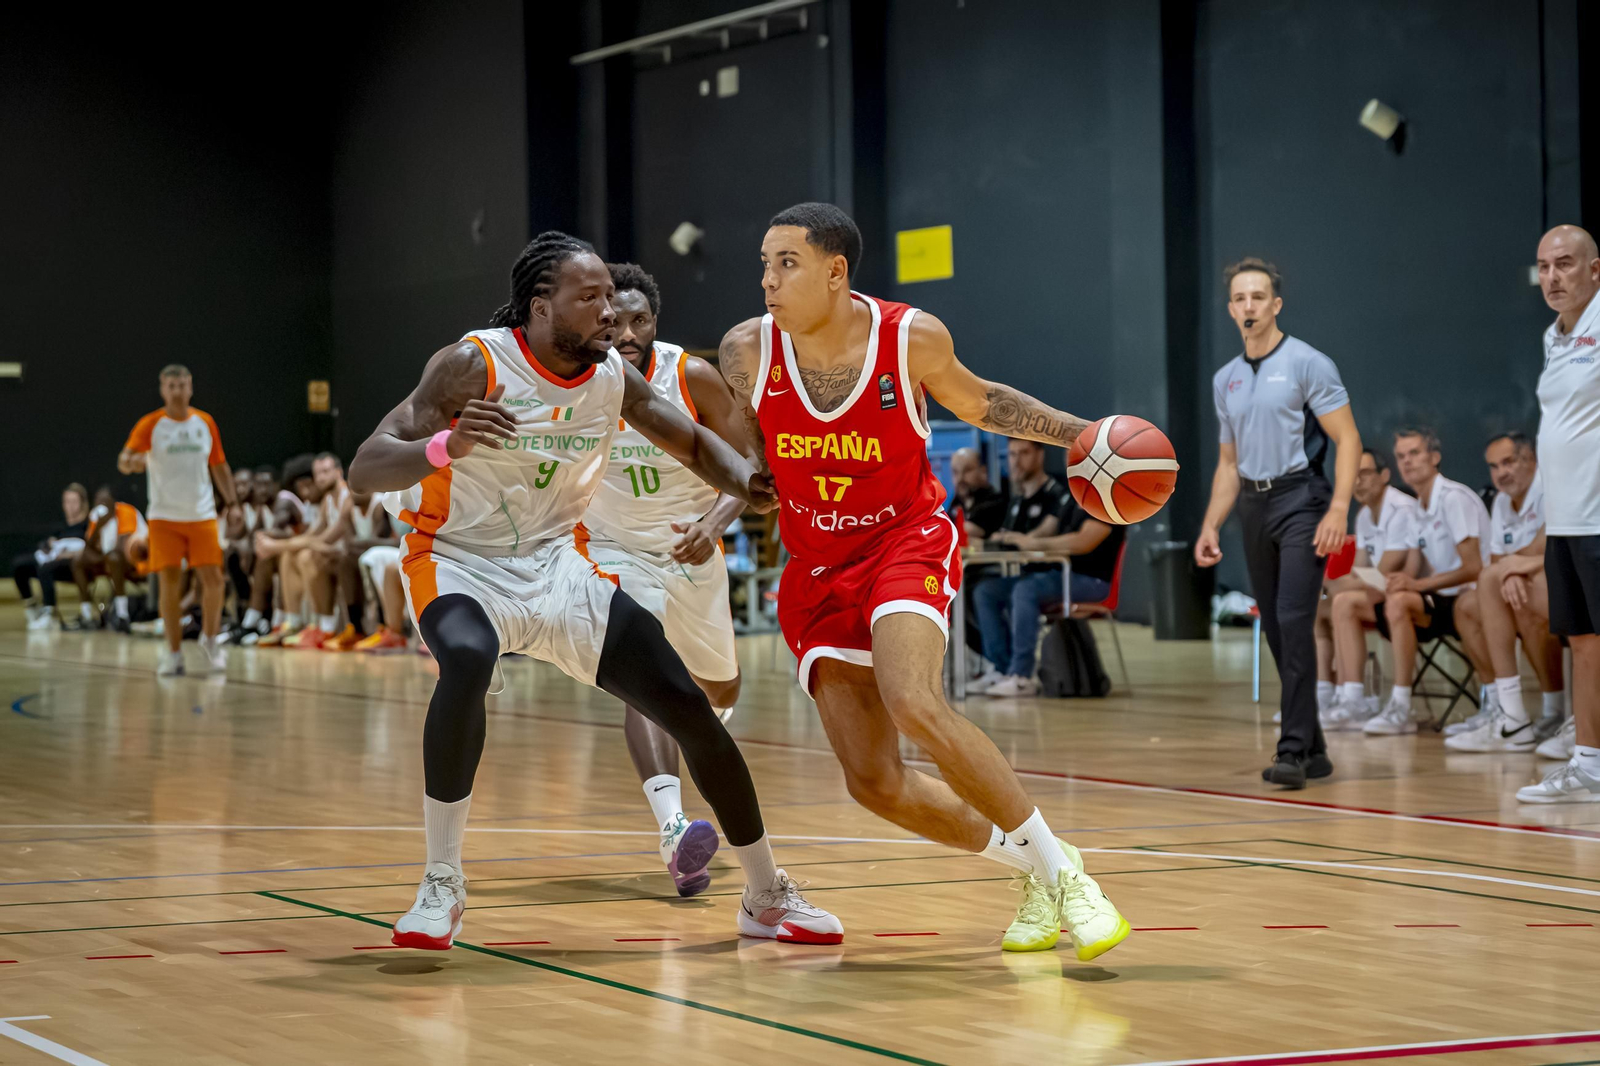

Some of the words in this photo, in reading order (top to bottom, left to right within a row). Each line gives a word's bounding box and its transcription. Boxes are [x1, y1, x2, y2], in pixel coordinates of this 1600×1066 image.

[502, 398, 532, 408] NUBA
[776, 431, 883, 462] ESPAÑA
[534, 460, 560, 489] 9
[622, 464, 660, 498] 10
[812, 475, 853, 502] 17
